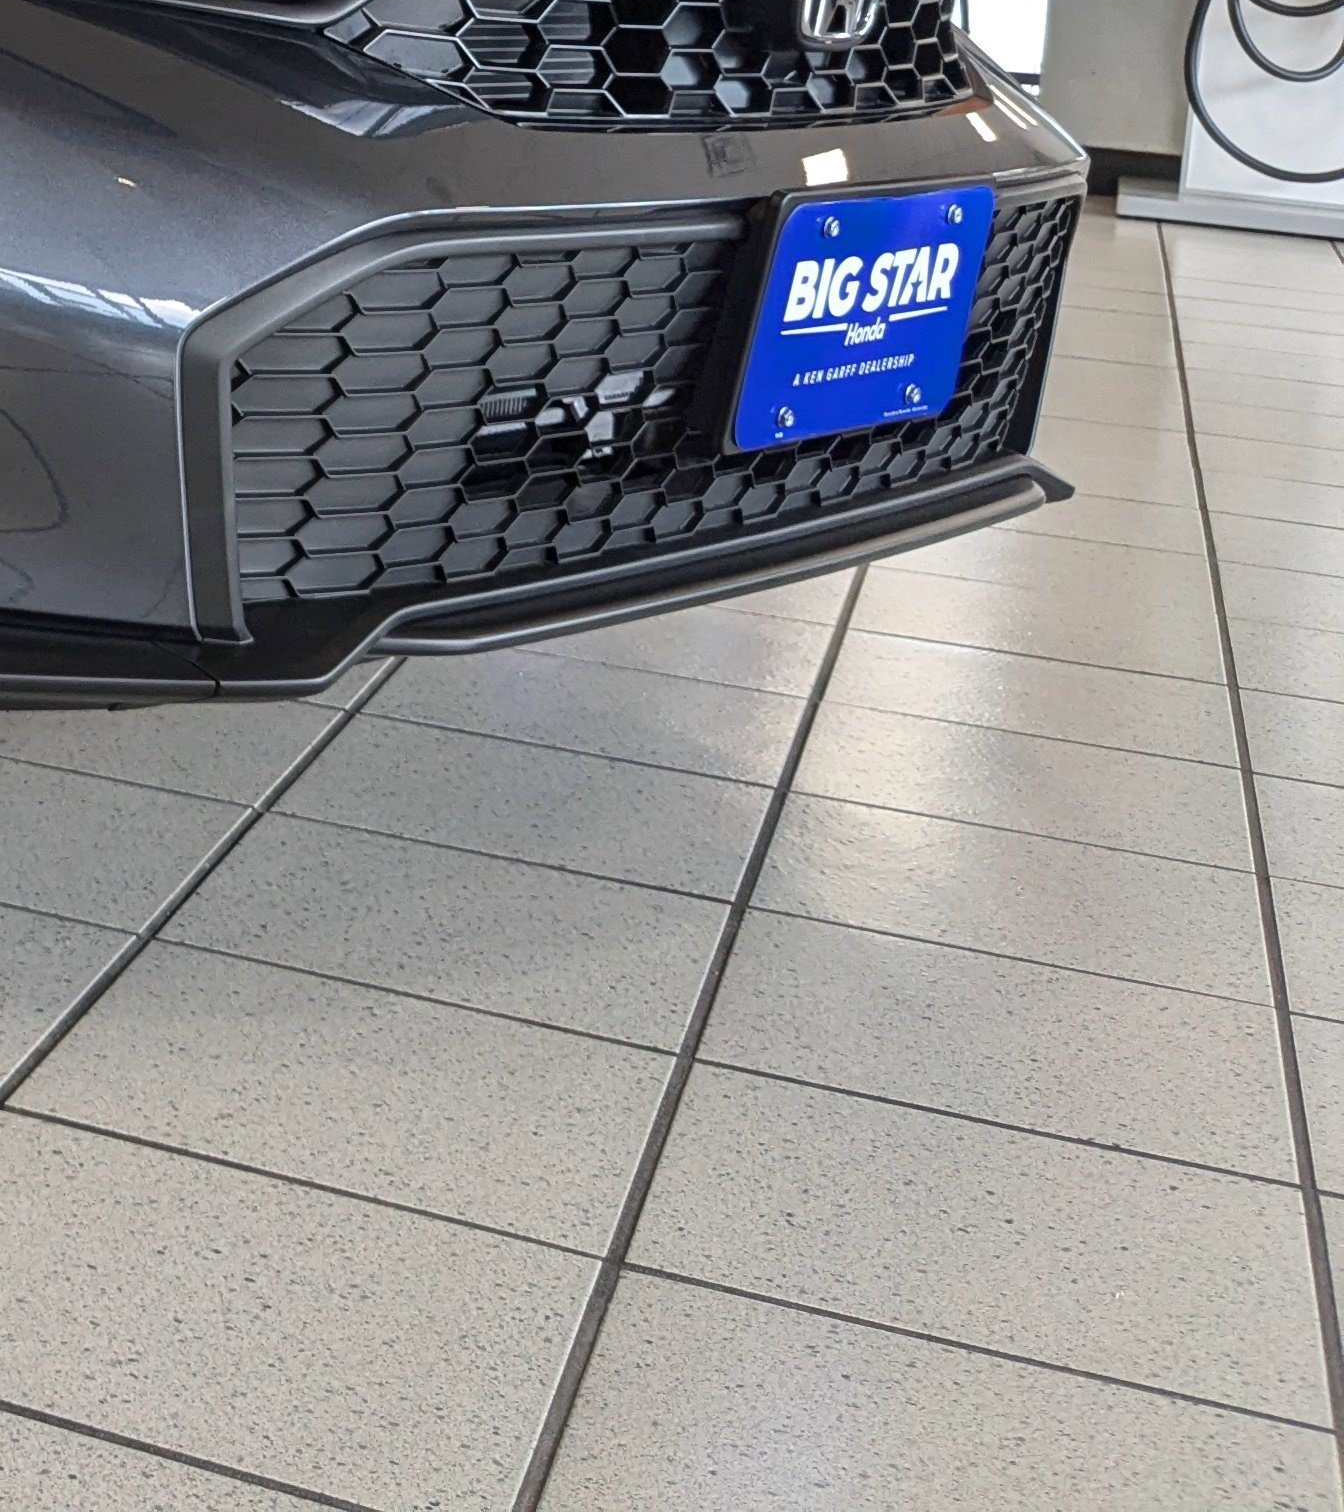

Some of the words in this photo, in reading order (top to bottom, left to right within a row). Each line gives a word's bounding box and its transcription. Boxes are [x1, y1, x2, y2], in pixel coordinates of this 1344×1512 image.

[783, 256, 863, 322] BIG
[862, 243, 959, 312] STAR
[844, 317, 886, 347] Honda
[792, 373, 800, 387] A
[803, 370, 824, 384] KEN
[826, 363, 857, 381] GARFF
[858, 353, 915, 375] DEALERSHIP
